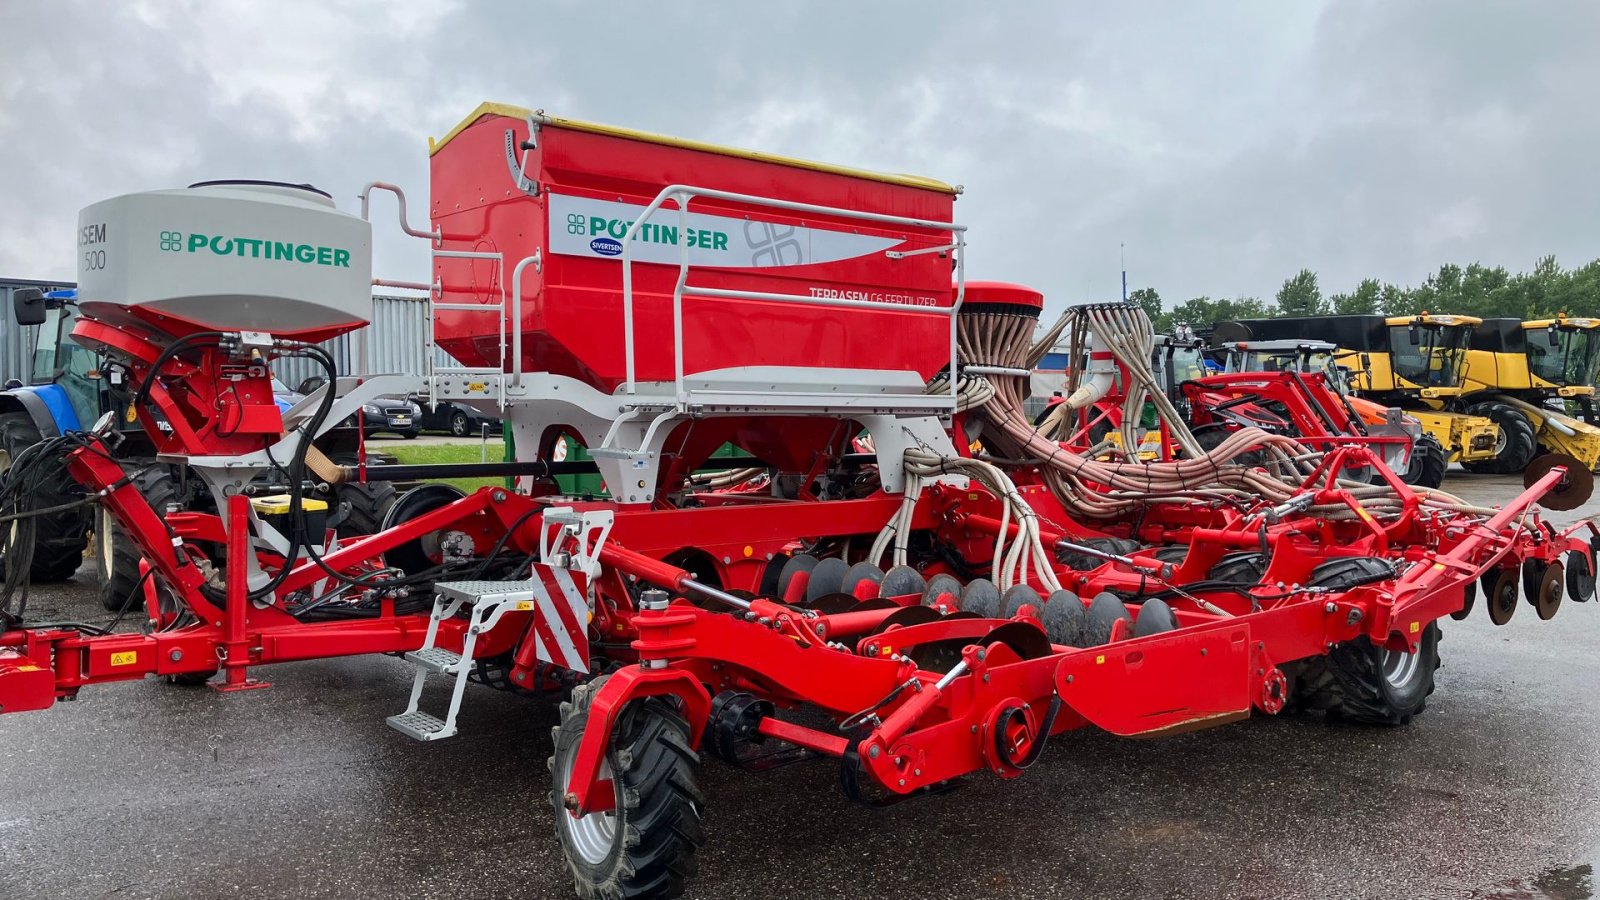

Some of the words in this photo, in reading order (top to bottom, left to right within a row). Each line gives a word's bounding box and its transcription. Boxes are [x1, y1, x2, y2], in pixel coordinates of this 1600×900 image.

[591, 241, 623, 252] SIVERTSEN
[85, 250, 106, 271] 500
[809, 287, 868, 301] TERRASEM
